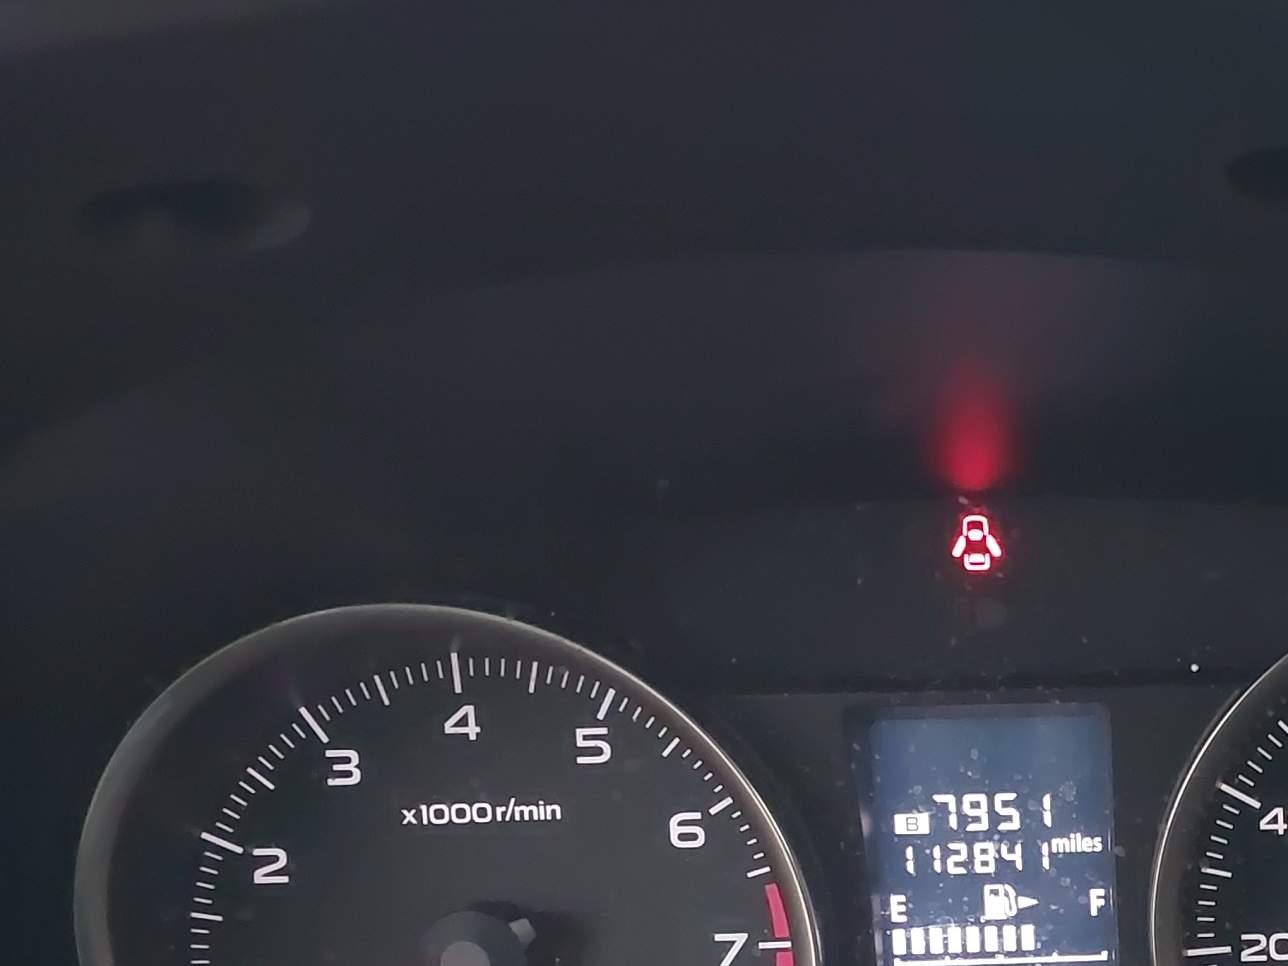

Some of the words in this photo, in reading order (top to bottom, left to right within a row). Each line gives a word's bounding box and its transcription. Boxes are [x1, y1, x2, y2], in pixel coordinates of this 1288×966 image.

[443, 704, 481, 741] 4
[575, 727, 612, 764] 5
[325, 749, 362, 786] 3
[495, 797, 562, 822] r/min
[932, 793, 1051, 831] 7951
[669, 812, 706, 849] 6
[252, 847, 290, 884] 2
[905, 841, 1050, 875] 112841
[1051, 833, 1103, 853] miles
[889, 894, 908, 923] E
[1089, 888, 1106, 917] F
[713, 932, 749, 966] 7
